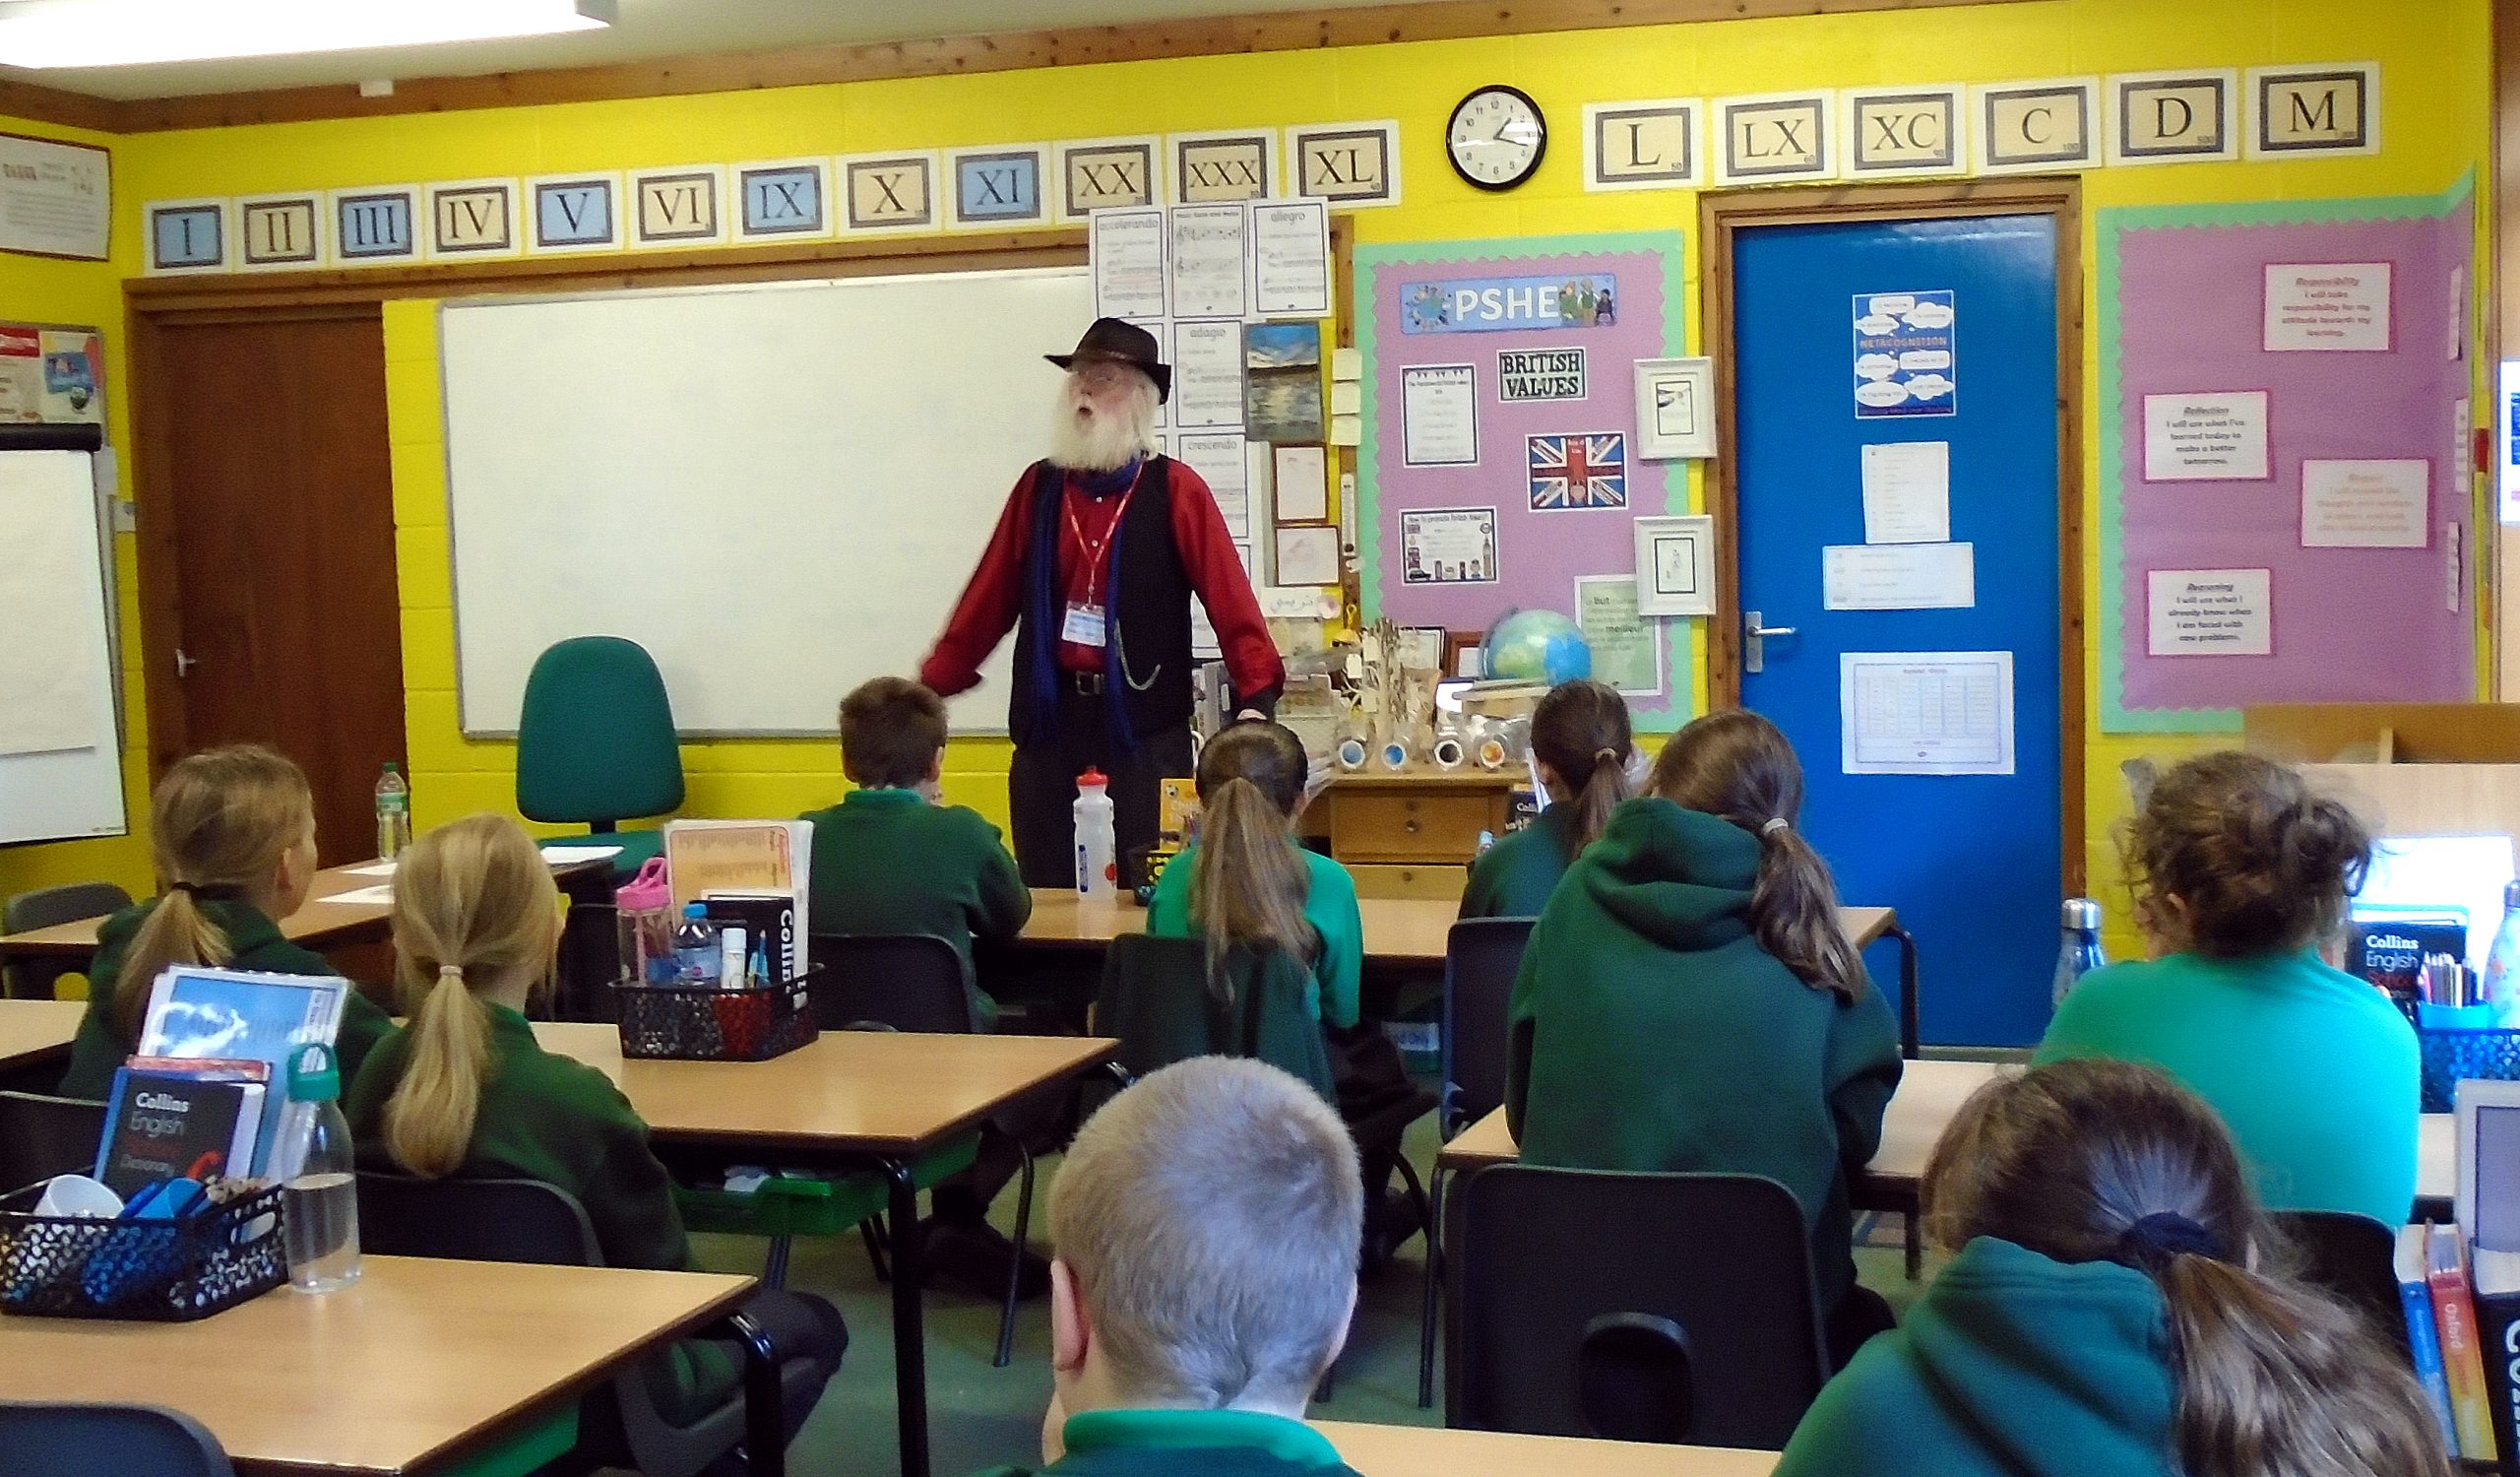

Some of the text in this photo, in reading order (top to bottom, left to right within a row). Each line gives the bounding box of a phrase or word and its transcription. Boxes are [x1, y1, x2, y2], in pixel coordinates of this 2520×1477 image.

[1490, 100, 1499, 109] 12
[2154, 97, 2193, 139] D
[2289, 90, 2337, 132] M
[1743, 119, 1806, 157] LX
[1872, 112, 1938, 150] XC
[2021, 107, 2051, 144] C
[1626, 123, 1662, 166] L
[1079, 161, 1139, 197] XX
[1188, 160, 1257, 188] XXX
[1313, 149, 1374, 185] XL
[759, 182, 804, 219] IX
[872, 173, 907, 214] X
[976, 168, 1019, 206] XI
[447, 199, 493, 238] IV
[557, 192, 589, 233] V
[653, 187, 700, 225] VI
[1271, 212, 1305, 225] allegro
[182, 219, 192, 256] I
[265, 212, 295, 252] II
[352, 206, 398, 245] III
[1455, 286, 1559, 321] PSHE
[1190, 328, 1226, 342] adagio
[1860, 337, 1947, 349] METACOGNITION
[1501, 353, 1580, 374] BRITISH
[1506, 376, 1579, 397] VALUES
[2183, 407, 2229, 417] Reflection
[1187, 439, 1236, 450] crescendo
[2365, 934, 2420, 949] Collins
[2365, 950, 2418, 972] English
[136, 1091, 189, 1113] Collins
[130, 1111, 185, 1138] English
[2445, 1303, 2464, 1350] Oxford
